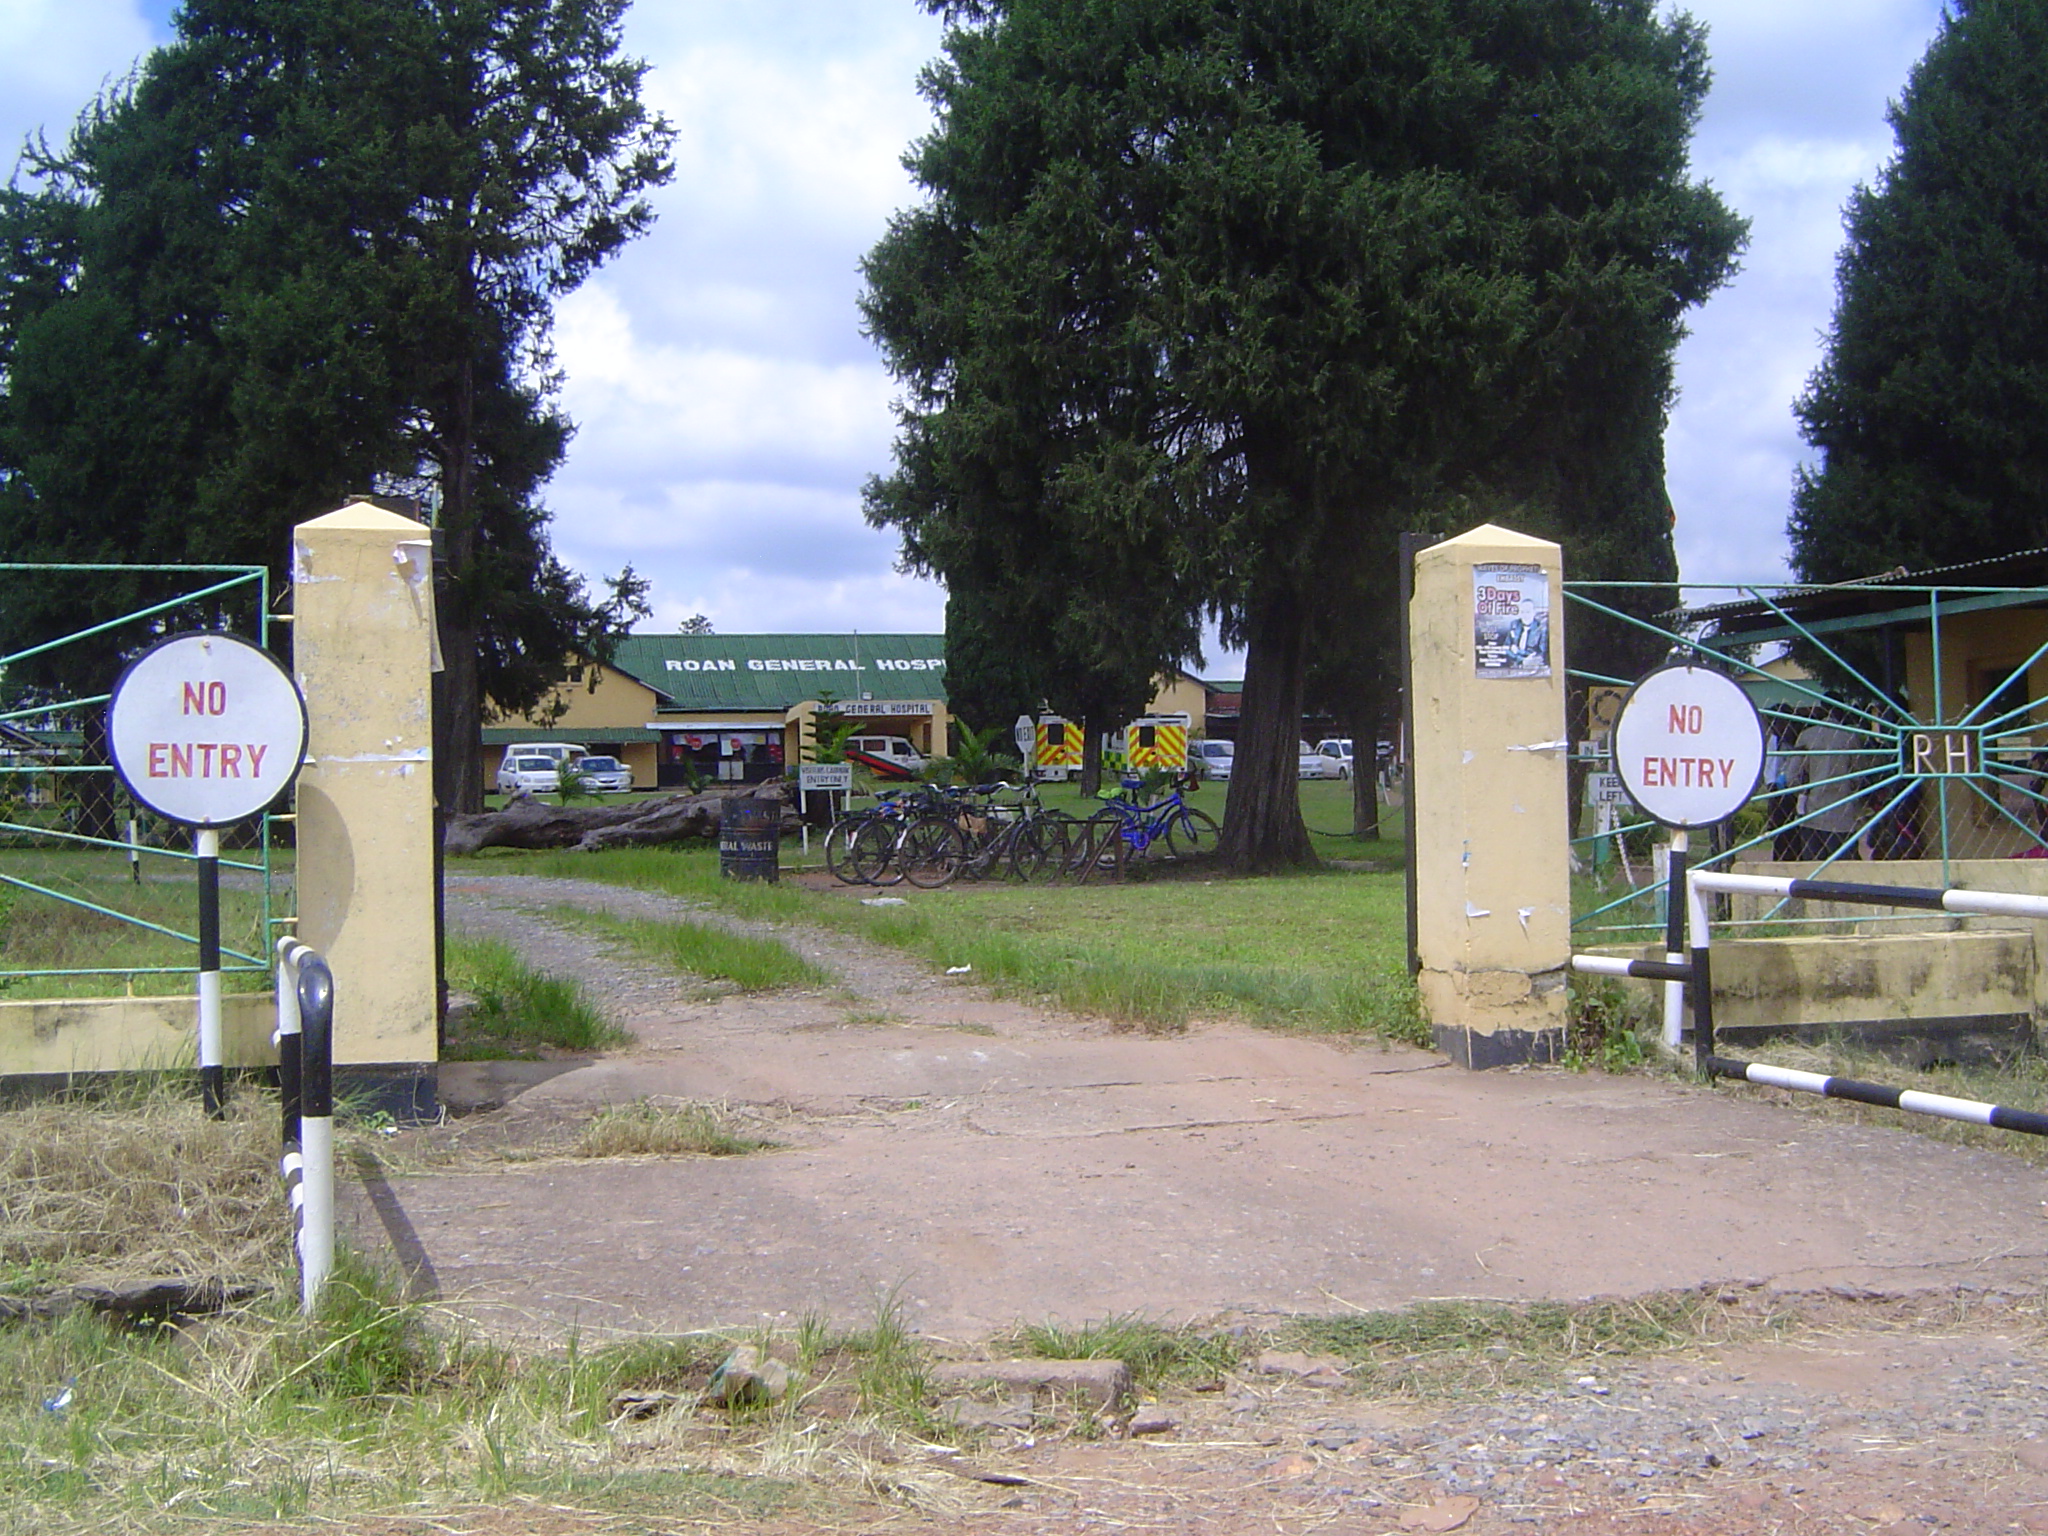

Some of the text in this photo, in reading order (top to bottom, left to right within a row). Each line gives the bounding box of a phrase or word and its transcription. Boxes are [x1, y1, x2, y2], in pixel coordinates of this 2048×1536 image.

[1477, 601, 1519, 615] Of Fire
[664, 659, 736, 671] ROAN
[747, 659, 866, 671] GENERAL
[182, 681, 226, 716] NO
[845, 704, 886, 714] GENERAL
[890, 703, 930, 713] HOSPITAL
[1668, 704, 1702, 734] NO
[148, 743, 268, 778] ENTRY
[1643, 757, 1735, 788] ENTRY
[1599, 790, 1624, 802] LEFT
